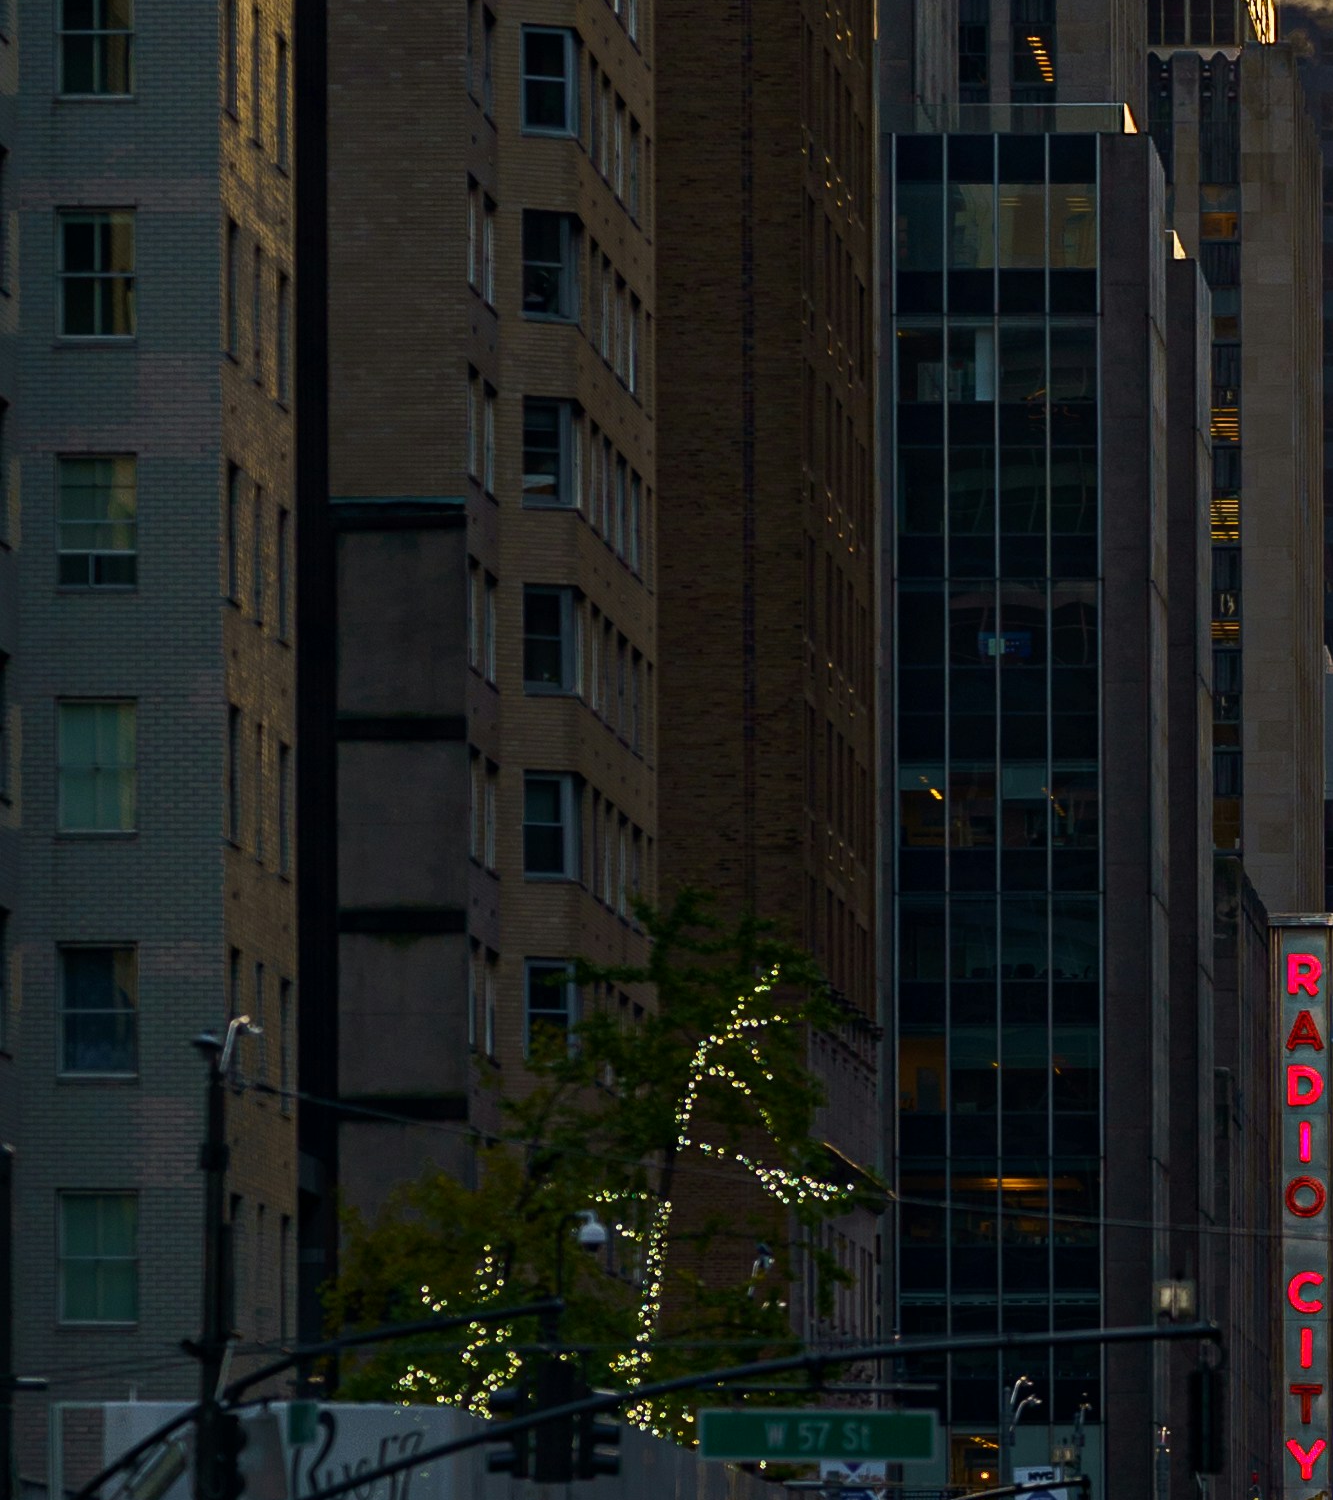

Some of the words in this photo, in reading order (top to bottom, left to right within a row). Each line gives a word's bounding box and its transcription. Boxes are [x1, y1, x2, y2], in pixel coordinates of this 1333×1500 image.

[1286, 952, 1326, 1218] RADIO
[1286, 1271, 1327, 1481] CITY
[764, 1421, 789, 1450] W
[798, 1421, 833, 1451] 57
[842, 1421, 872, 1452] St
[1028, 1471, 1055, 1482] NYC
